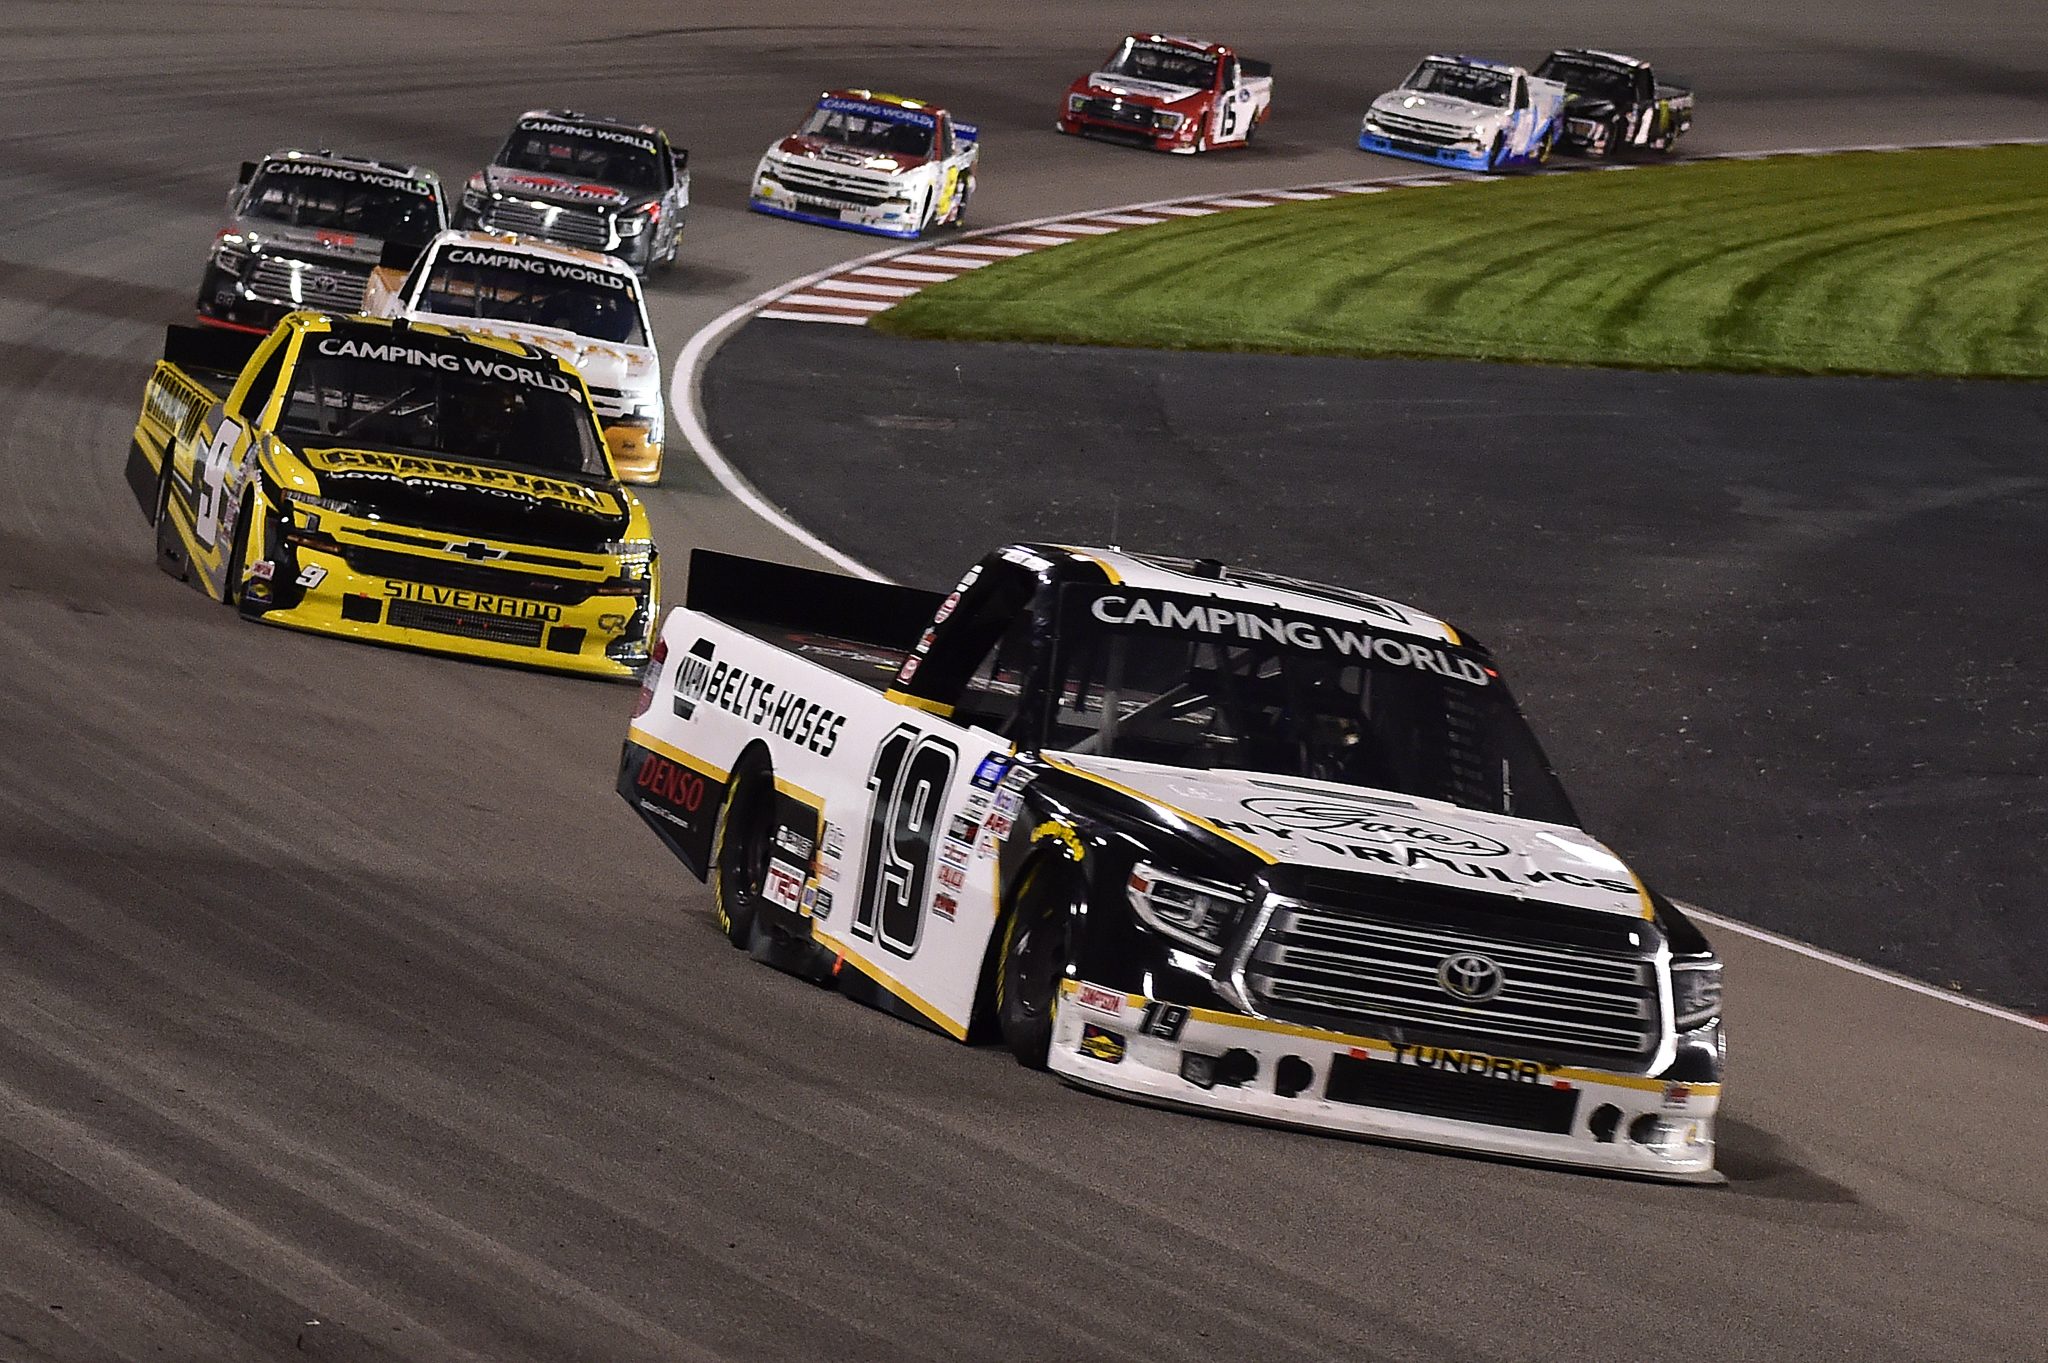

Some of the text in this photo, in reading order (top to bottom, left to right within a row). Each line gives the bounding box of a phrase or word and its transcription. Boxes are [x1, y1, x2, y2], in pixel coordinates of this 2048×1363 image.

[520, 120, 655, 151] CAMPING WORLD
[823, 100, 881, 115] CAMPING
[884, 109, 932, 128] WORLD
[266, 163, 431, 196] CAMPING WORLD
[448, 250, 625, 290] CAMPING WORLD
[318, 338, 460, 372] CAMPING
[464, 357, 571, 394] WORLD
[196, 415, 243, 550] 9
[295, 562, 328, 590] 9
[383, 579, 562, 623] SILVERADO
[1091, 595, 1489, 687] CAMPING WORLD
[637, 753, 704, 813] DENSO
[850, 721, 959, 960] 19
[1268, 805, 1500, 853] Gates
[1143, 1000, 1191, 1042] 19
[1390, 1040, 1541, 1084] TUNDRA
